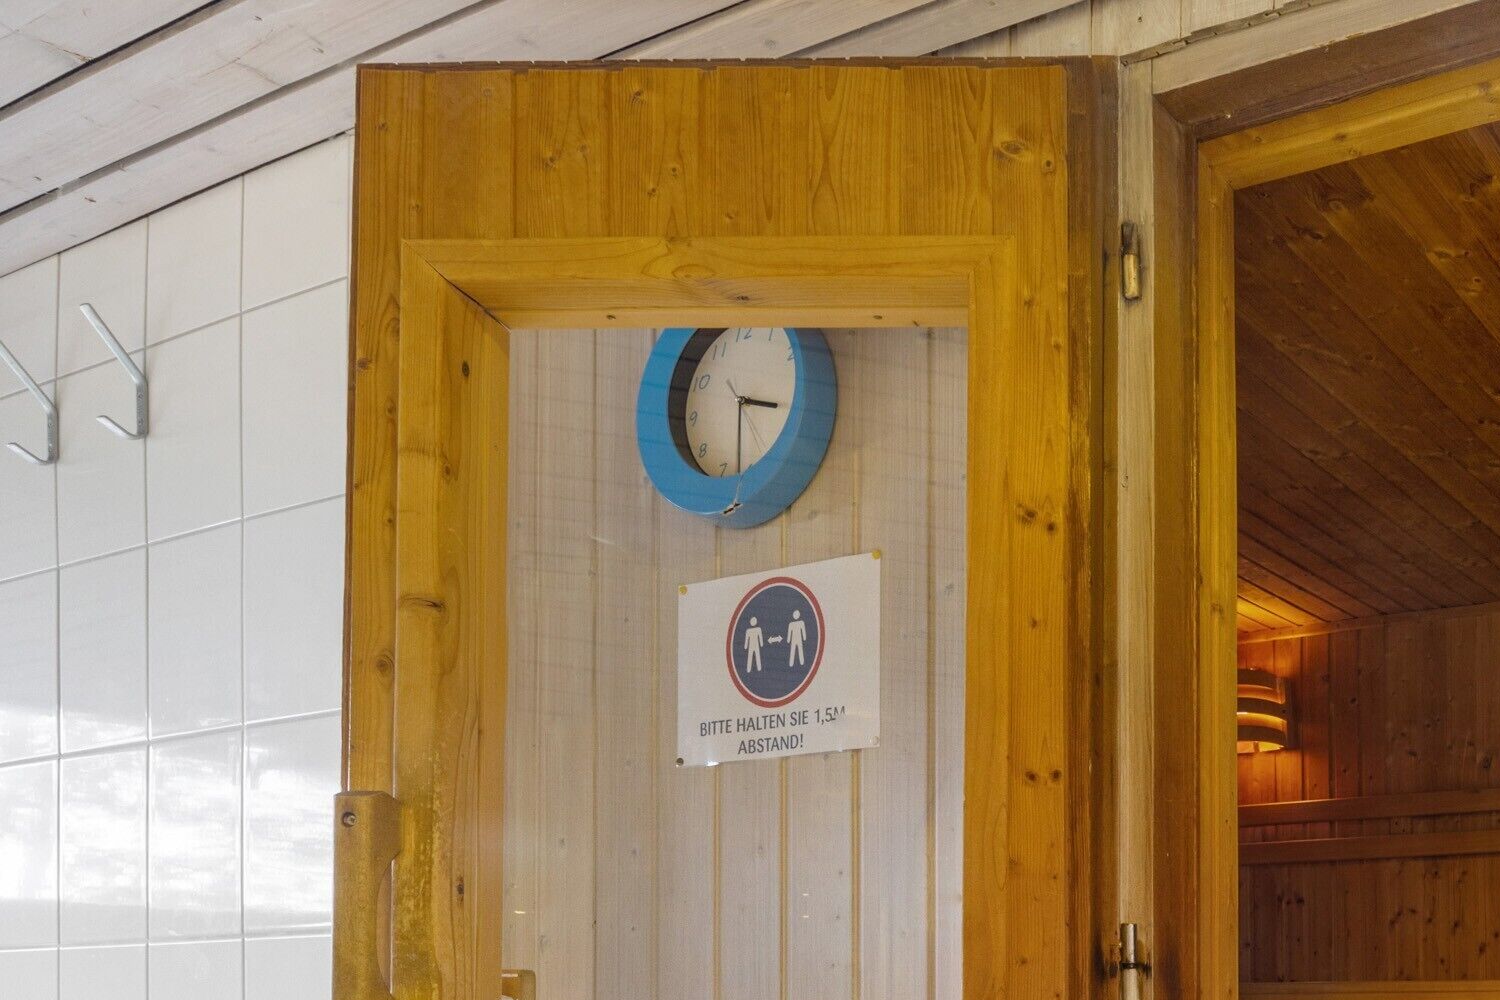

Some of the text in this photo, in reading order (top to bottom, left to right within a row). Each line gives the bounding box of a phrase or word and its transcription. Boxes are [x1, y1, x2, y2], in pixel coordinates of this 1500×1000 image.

[692, 373, 711, 393] 10
[689, 410, 698, 427] 9
[700, 442, 708, 458] 8
[699, 718, 733, 737] BITTE
[736, 712, 786, 733] HALTEN
[789, 709, 809, 727] SIE
[737, 733, 804, 755] ABSTAND!
